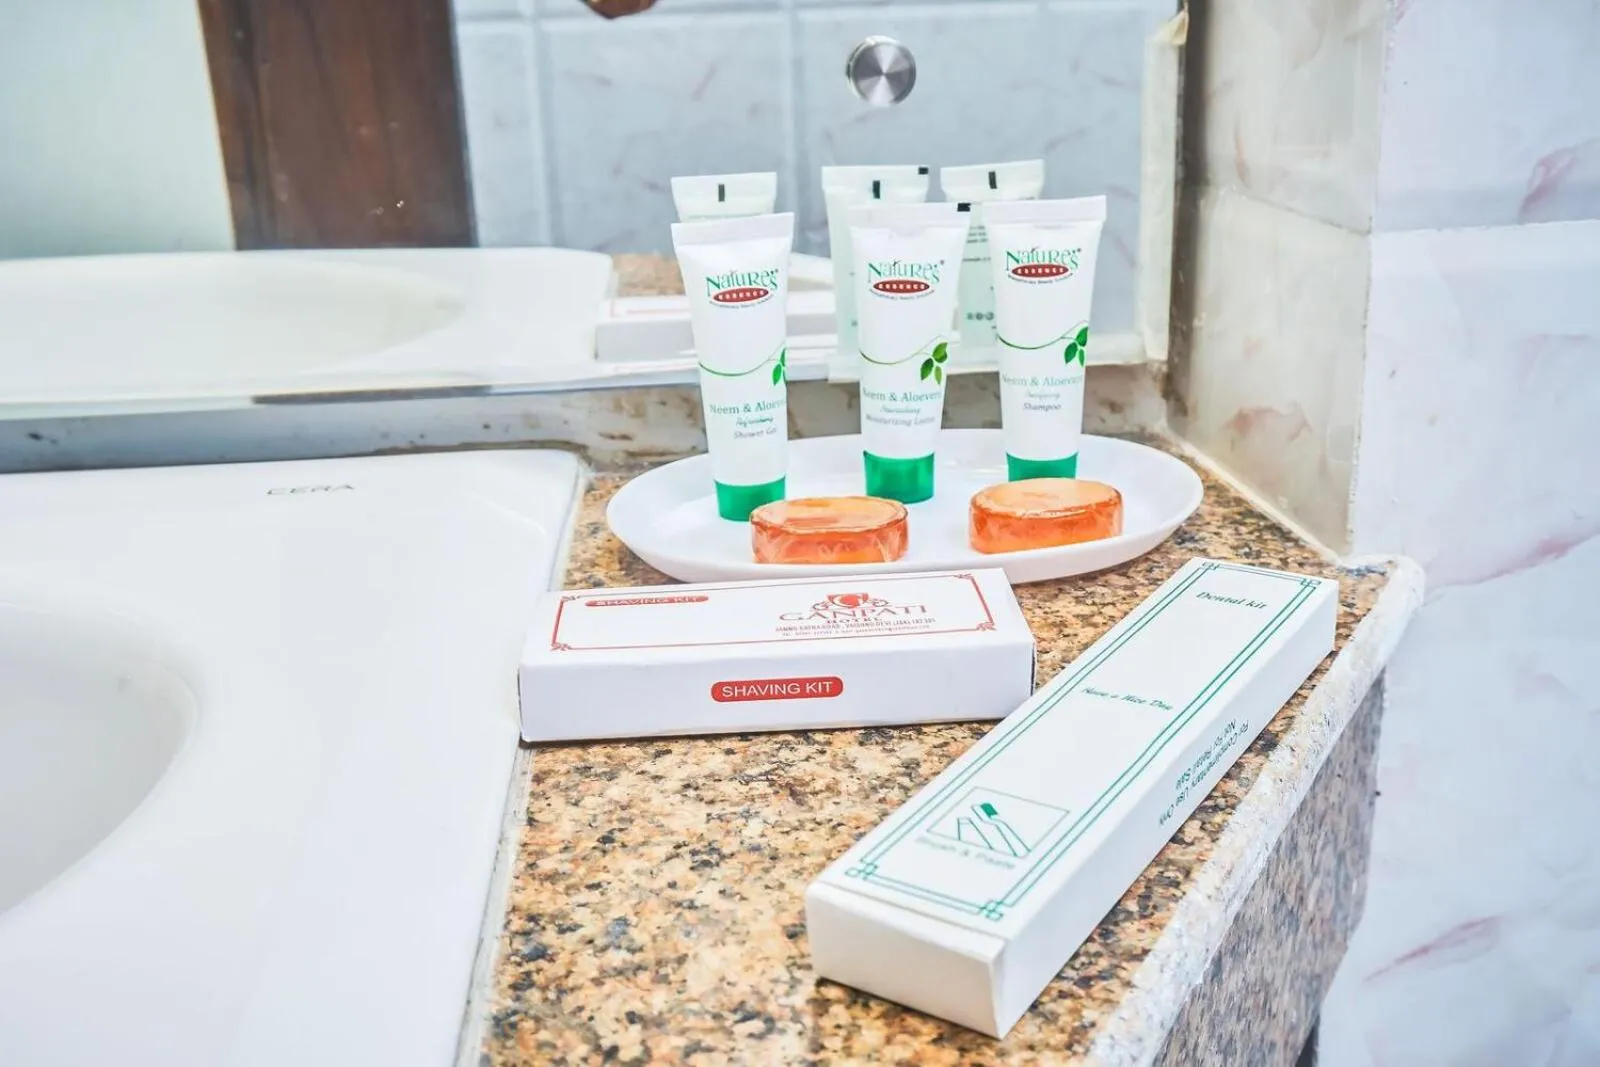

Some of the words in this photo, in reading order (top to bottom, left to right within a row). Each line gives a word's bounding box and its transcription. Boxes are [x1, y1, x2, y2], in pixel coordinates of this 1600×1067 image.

[889, 392, 898, 401] &
[709, 404, 740, 415] Neem
[742, 402, 752, 413] &
[1023, 402, 1062, 412] Shampoo
[734, 429, 764, 439] Shower
[266, 484, 355, 496] CERA
[594, 597, 669, 606] SHAVING
[674, 595, 699, 603] KIT
[1196, 591, 1245, 606] Dental
[778, 604, 928, 621] GANPATI
[721, 682, 801, 698] SHAVING
[805, 681, 834, 694] KIT
